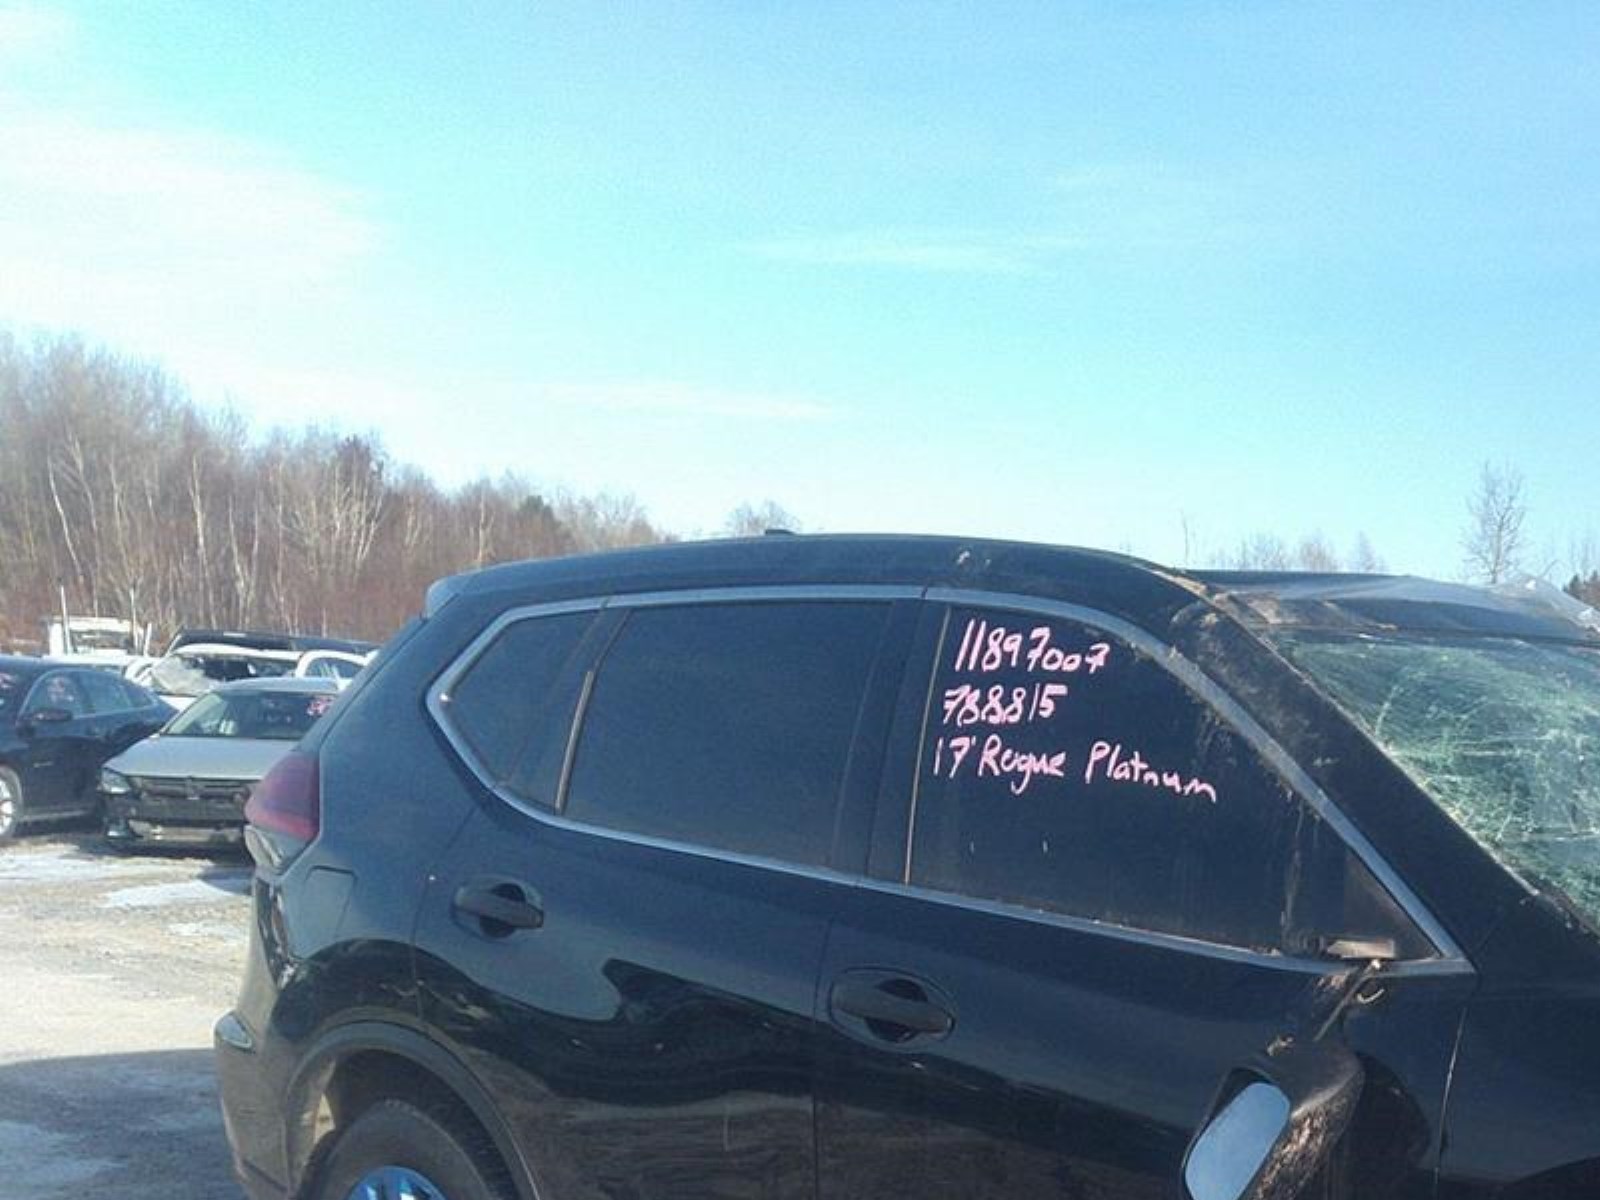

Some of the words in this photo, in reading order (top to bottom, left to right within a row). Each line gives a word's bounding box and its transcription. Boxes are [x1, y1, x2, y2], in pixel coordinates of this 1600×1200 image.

[953, 618, 1111, 673] 11897007
[942, 683, 1068, 727] 788815
[977, 733, 1066, 795] Rogue
